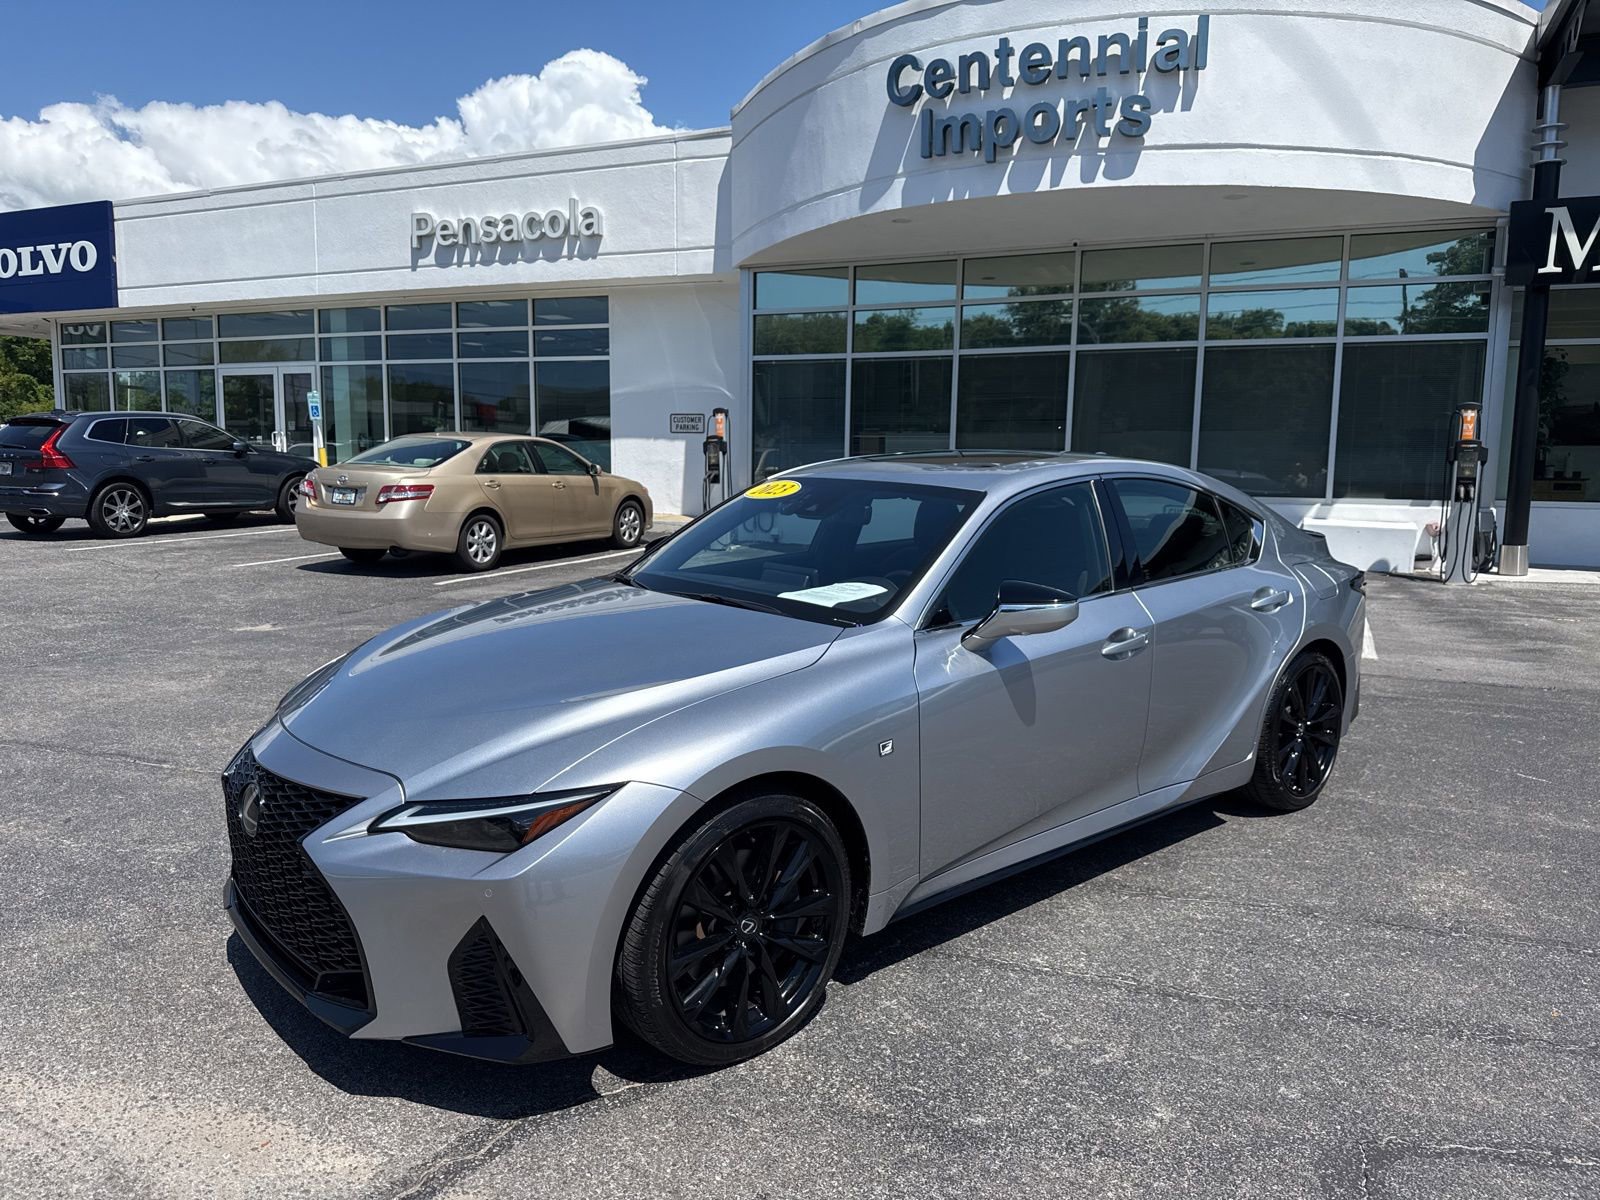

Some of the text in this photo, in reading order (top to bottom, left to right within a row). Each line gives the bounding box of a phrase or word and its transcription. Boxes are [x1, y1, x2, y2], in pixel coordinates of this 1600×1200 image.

[887, 15, 1210, 107] Centennial
[920, 87, 1152, 163] Imports
[411, 197, 604, 250] Pensacola
[0, 240, 98, 279] OLVO
[675, 423, 700, 431] PARKING
